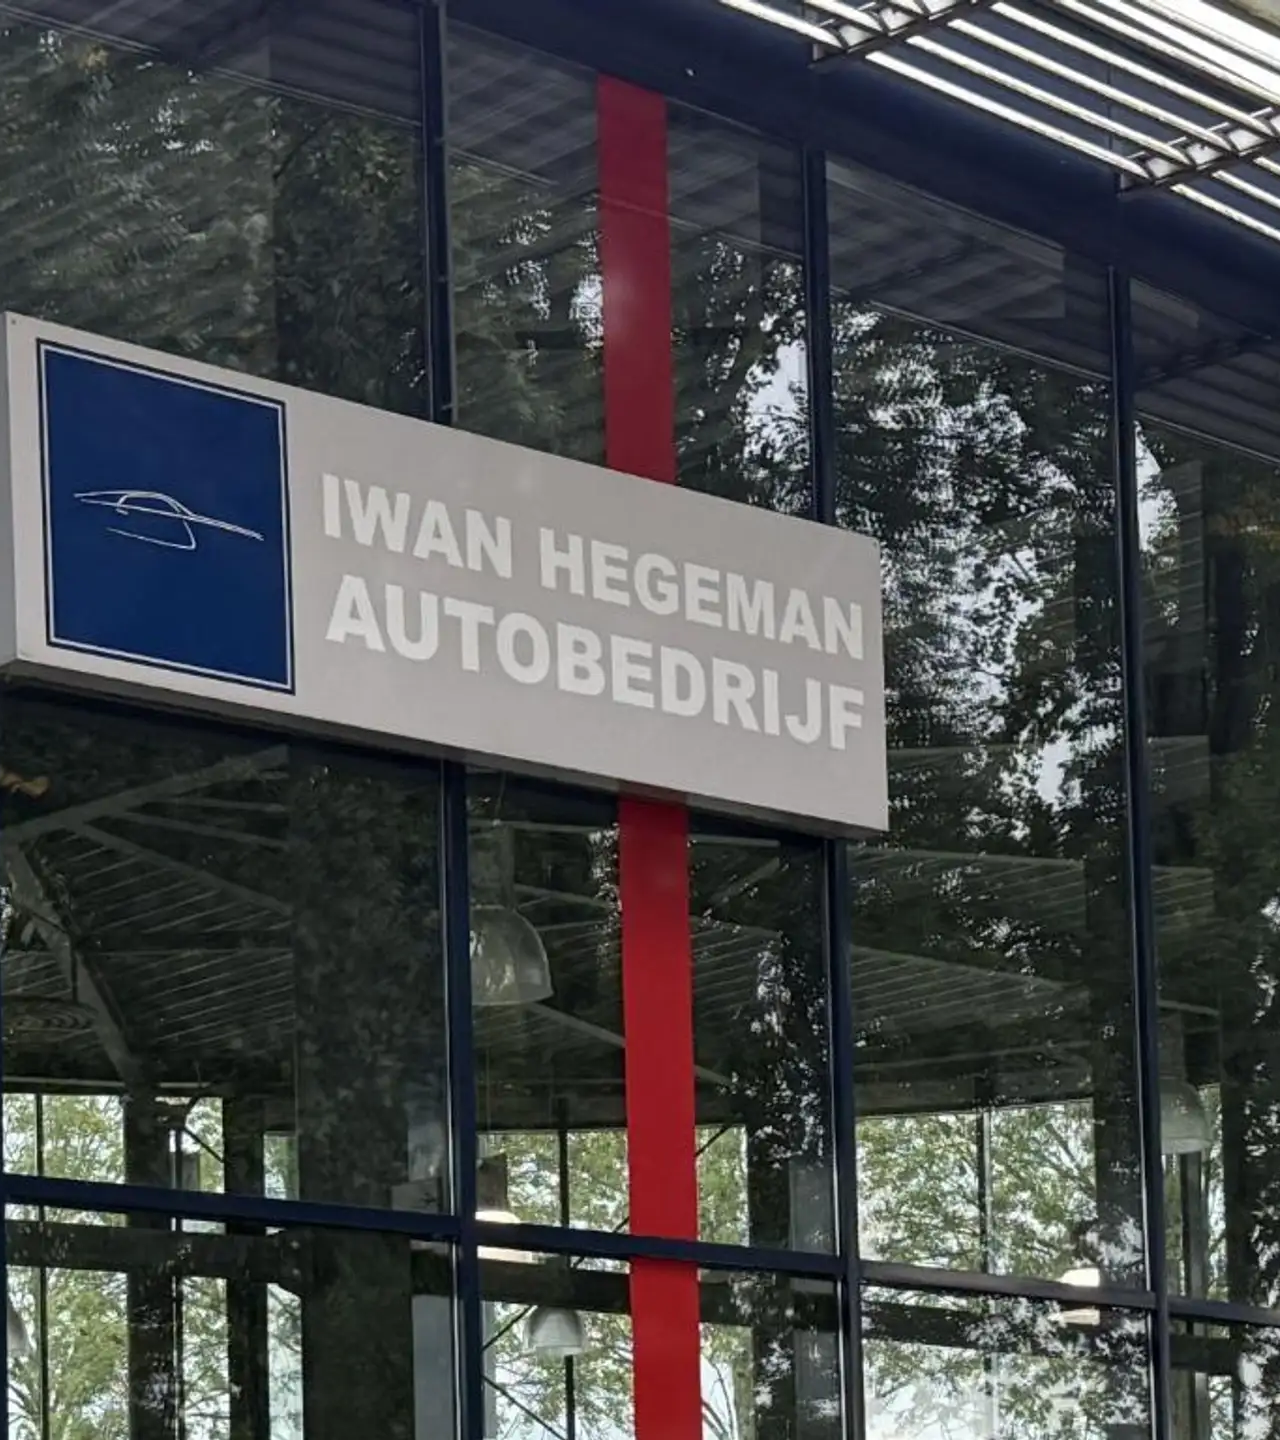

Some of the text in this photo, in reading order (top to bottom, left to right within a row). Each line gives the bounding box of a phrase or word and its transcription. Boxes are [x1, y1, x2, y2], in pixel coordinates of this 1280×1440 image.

[322, 473, 865, 660] IWAN HEGEMAN
[325, 574, 865, 750] AUTOBEDRIJF
